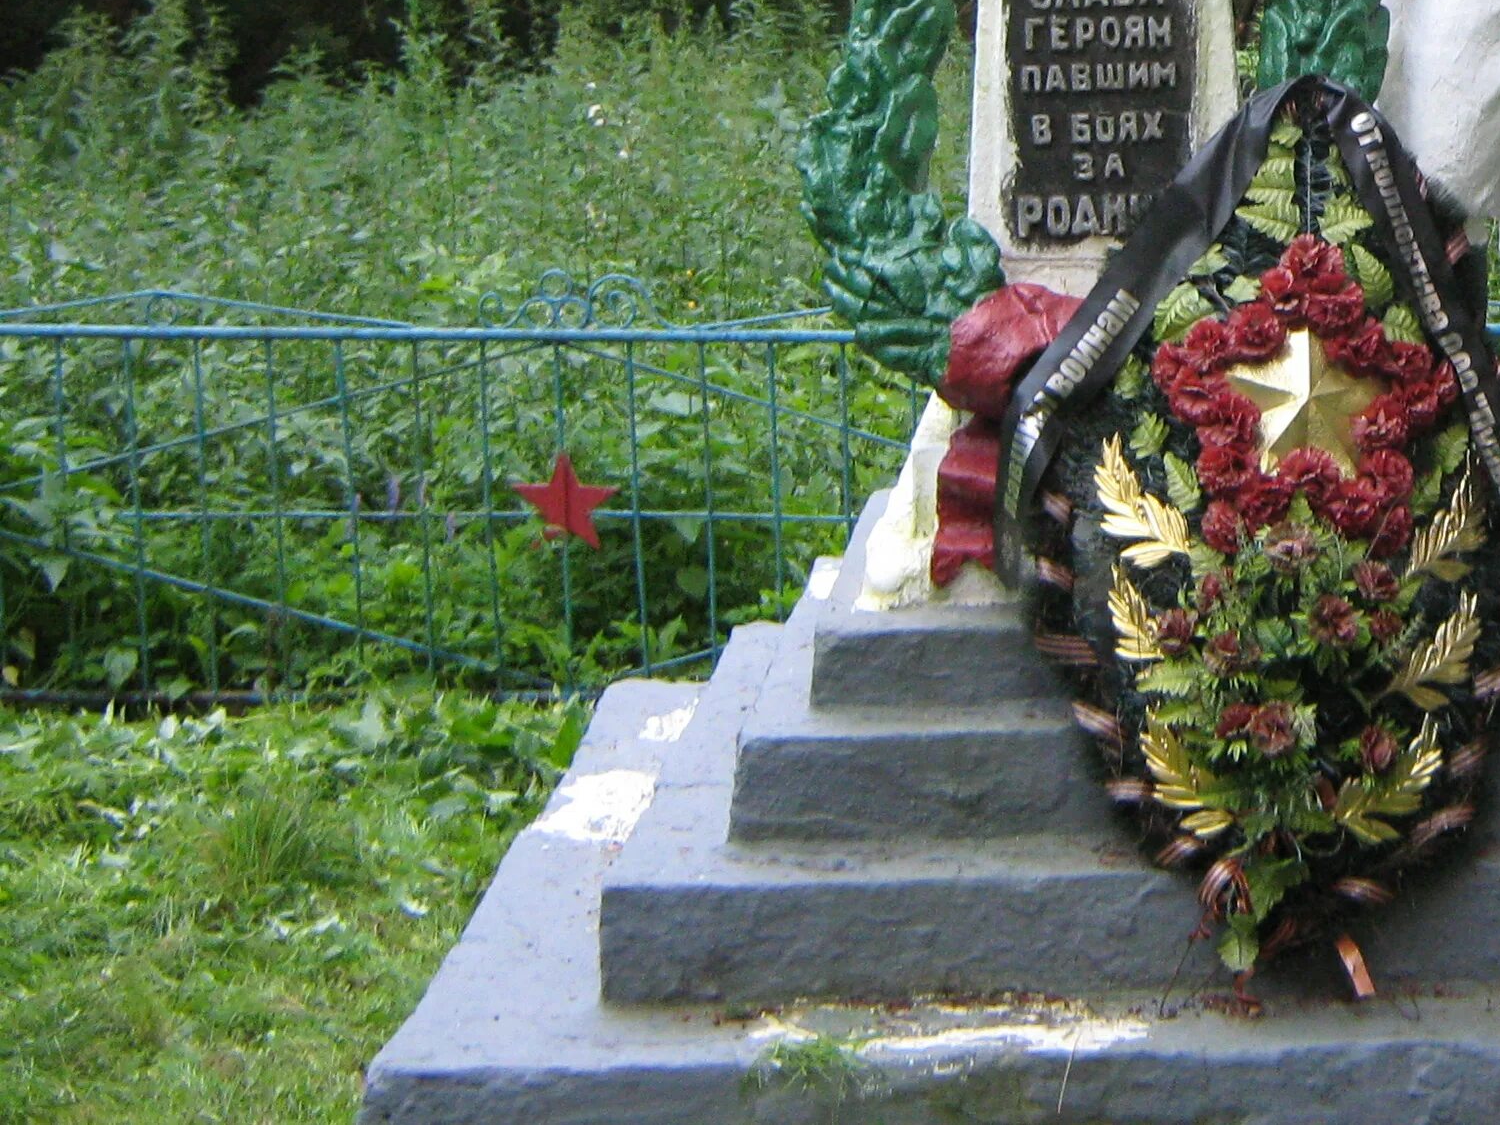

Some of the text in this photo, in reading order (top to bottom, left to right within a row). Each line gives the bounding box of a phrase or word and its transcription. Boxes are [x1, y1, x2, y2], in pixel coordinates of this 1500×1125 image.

[1023, 14, 1174, 51] ГЕРОЯМ
[1019, 60, 1178, 93] ПАВШИМ
[1031, 109, 1165, 147] В БОЯХ
[1073, 151, 1126, 181] ЗА
